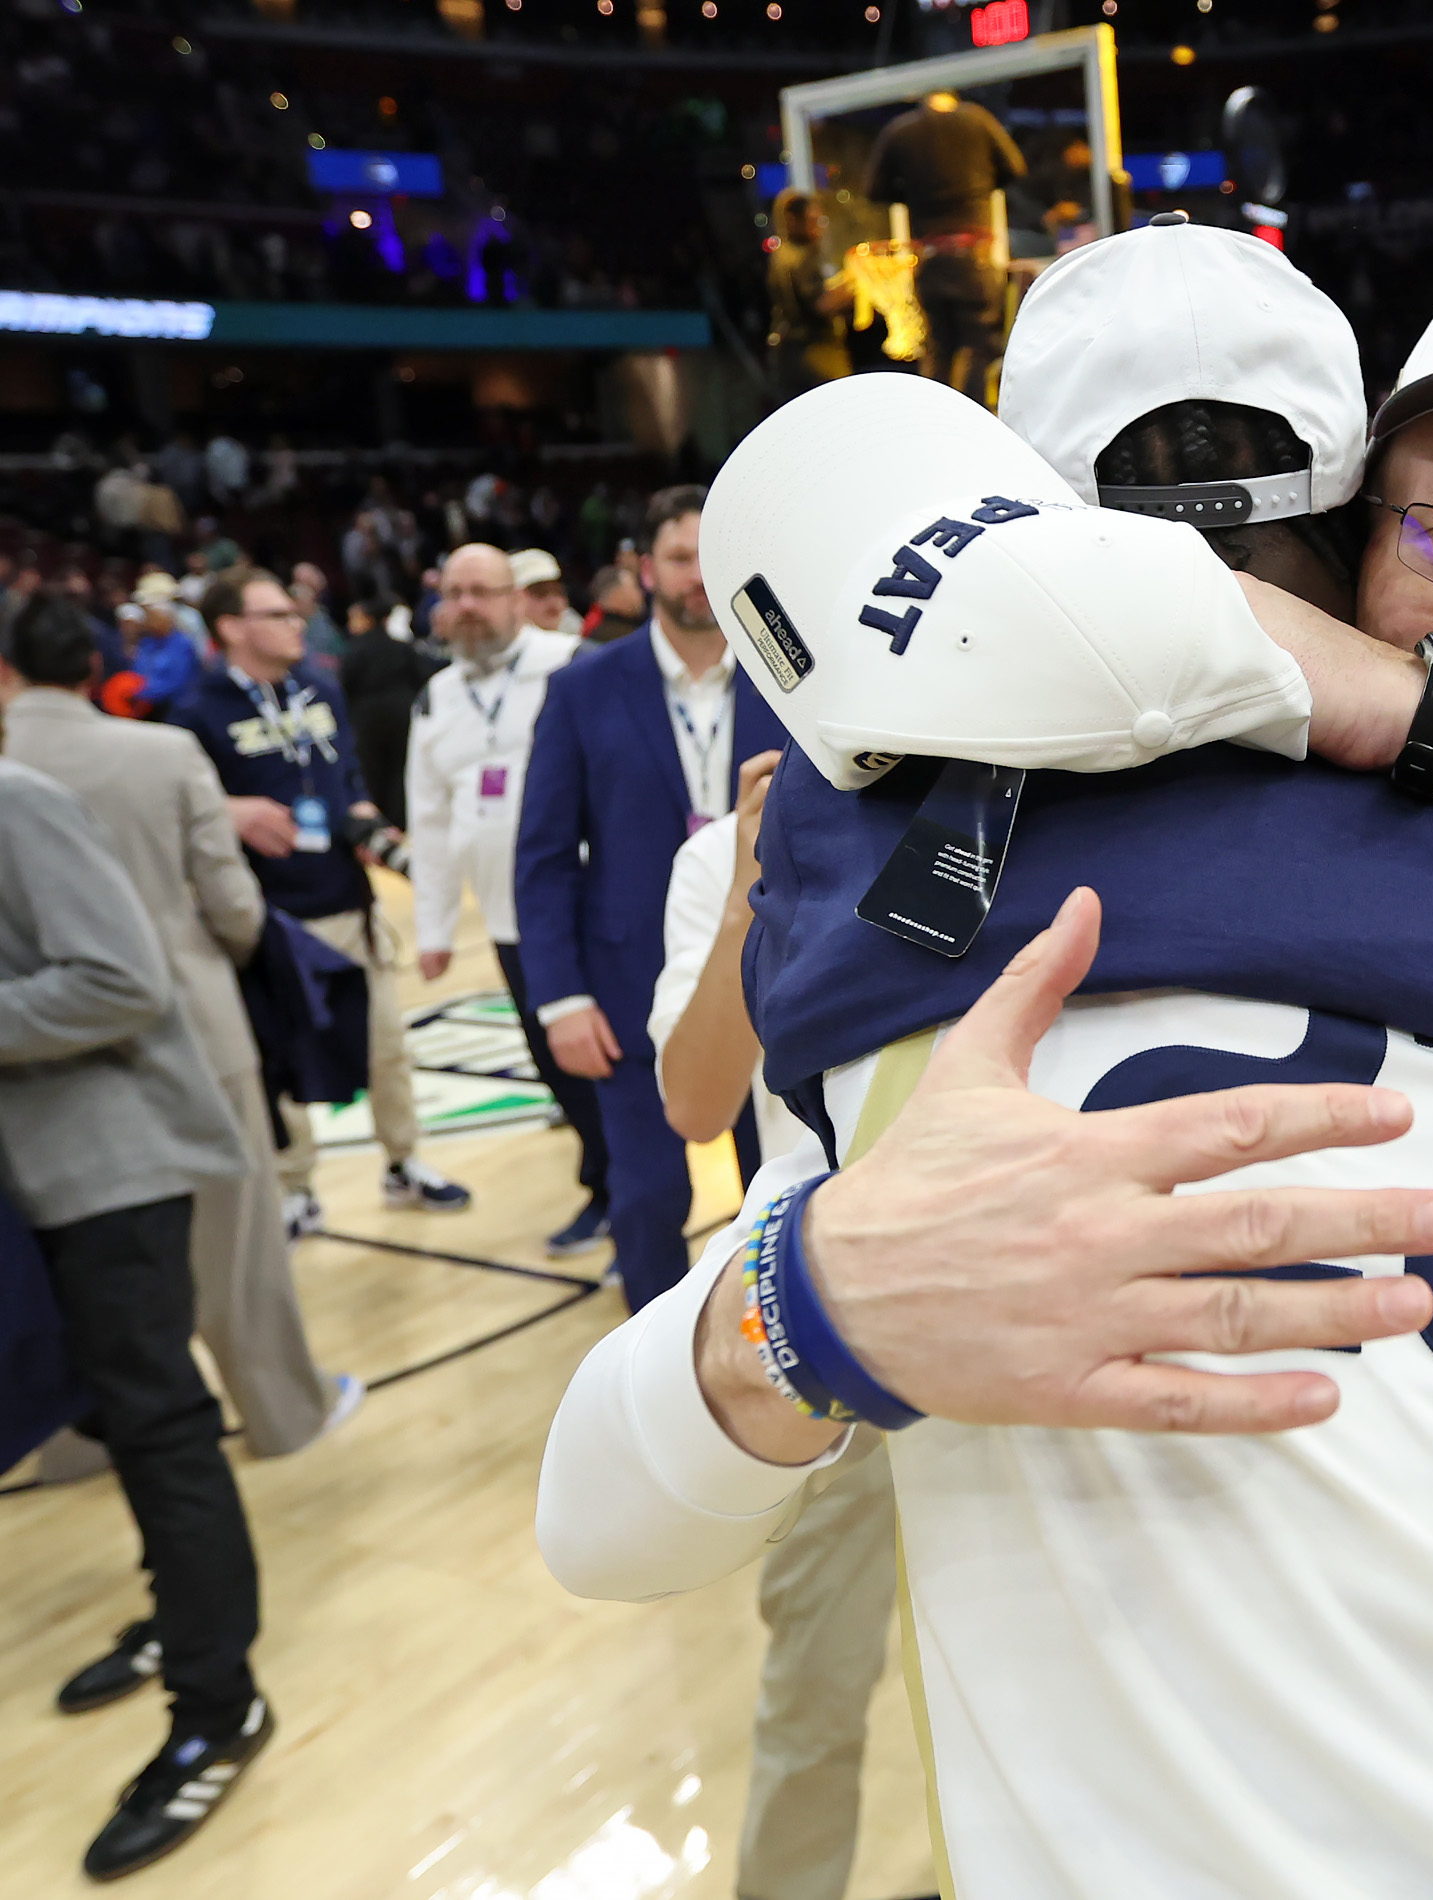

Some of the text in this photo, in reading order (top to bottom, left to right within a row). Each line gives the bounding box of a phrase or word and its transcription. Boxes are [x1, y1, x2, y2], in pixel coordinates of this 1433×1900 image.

[858, 495, 1039, 656] PEAT
[757, 637, 788, 686] PERFORMANCE
[760, 627, 793, 681] Ultimate Fit
[765, 609, 802, 660] ahead
[759, 1218, 799, 1370] DISCIPLINE
